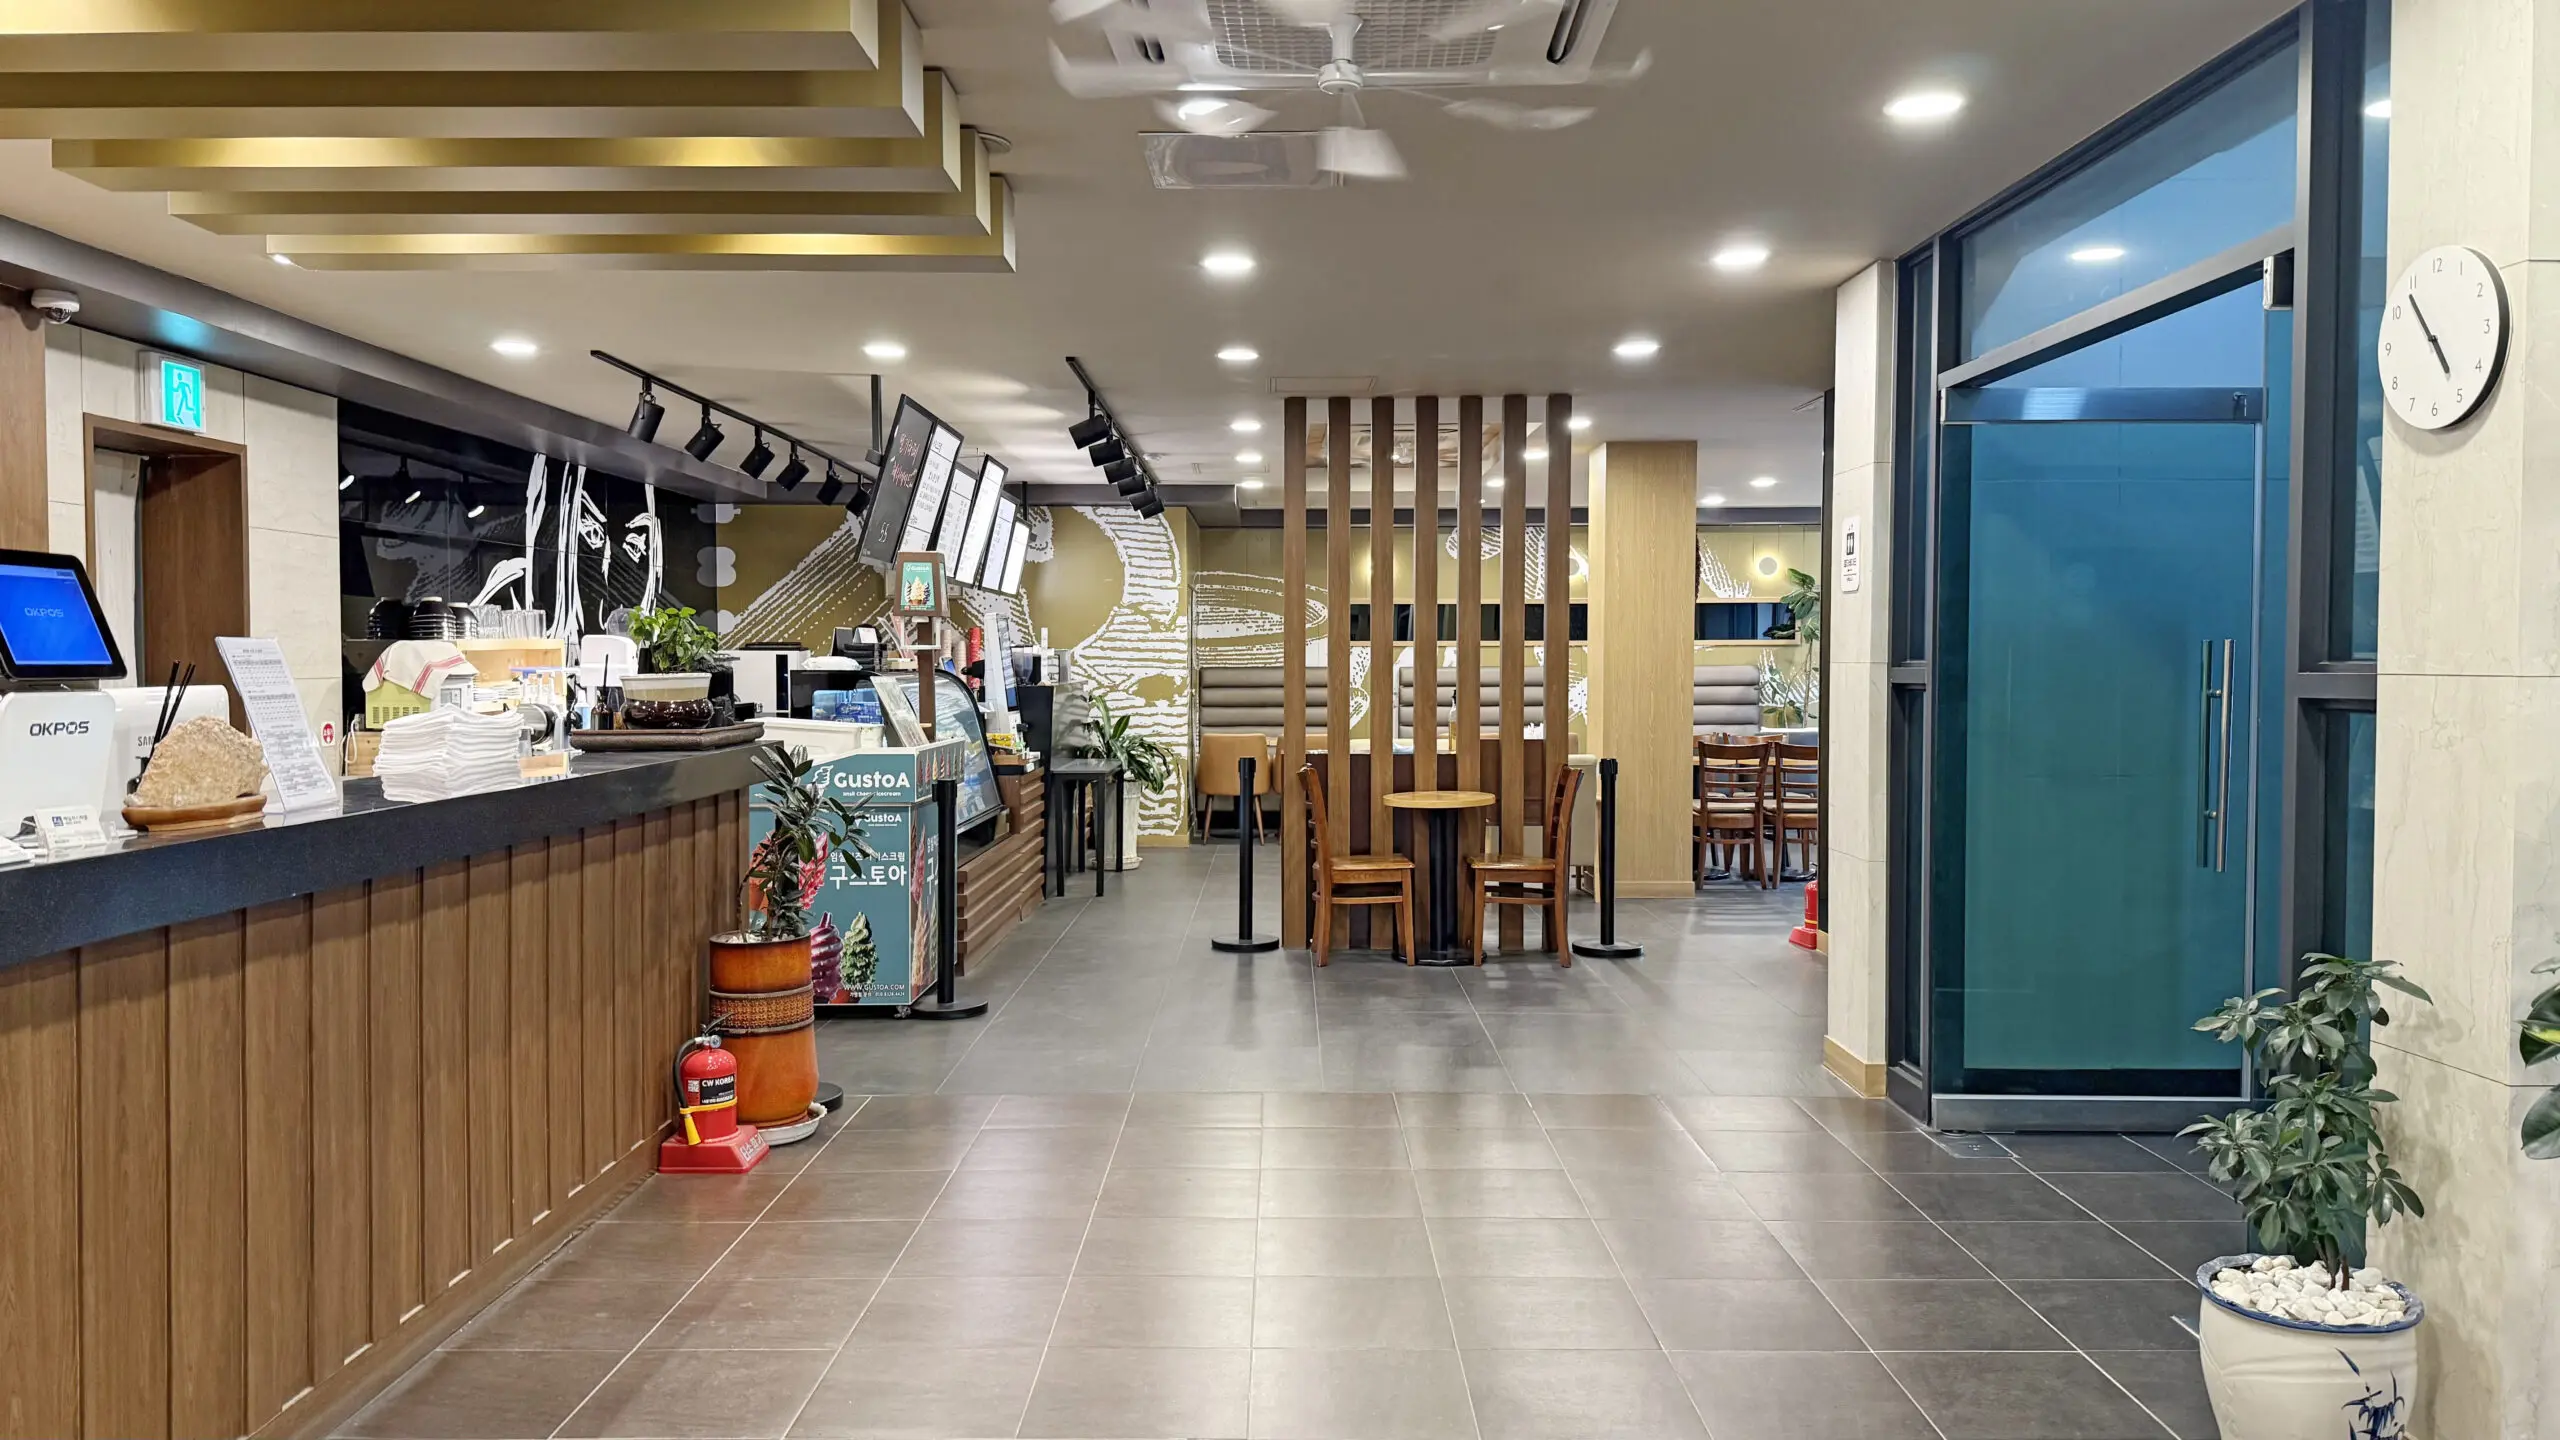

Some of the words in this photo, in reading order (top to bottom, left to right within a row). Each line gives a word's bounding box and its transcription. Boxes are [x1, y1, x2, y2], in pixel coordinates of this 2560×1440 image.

[2432, 258, 2443, 273] 12
[2409, 275, 2417, 289] 11
[2477, 282, 2484, 298] 2
[2392, 305, 2402, 320] 10
[2484, 319, 2490, 334] 3
[2385, 342, 2391, 356] 9
[2475, 357, 2482, 372] 4
[2392, 376, 2398, 390] 8
[2456, 388, 2463, 403] 5
[2409, 398, 2415, 412] 7
[2431, 402, 2438, 416] 6
[24, 607, 64, 618] OKPOS
[29, 720, 90, 737] OKPOS
[833, 771, 910, 789] GustoA
[829, 865, 908, 890] 구스토아
[701, 1079, 714, 1087] CW
[715, 1075, 734, 1086] KOREA
